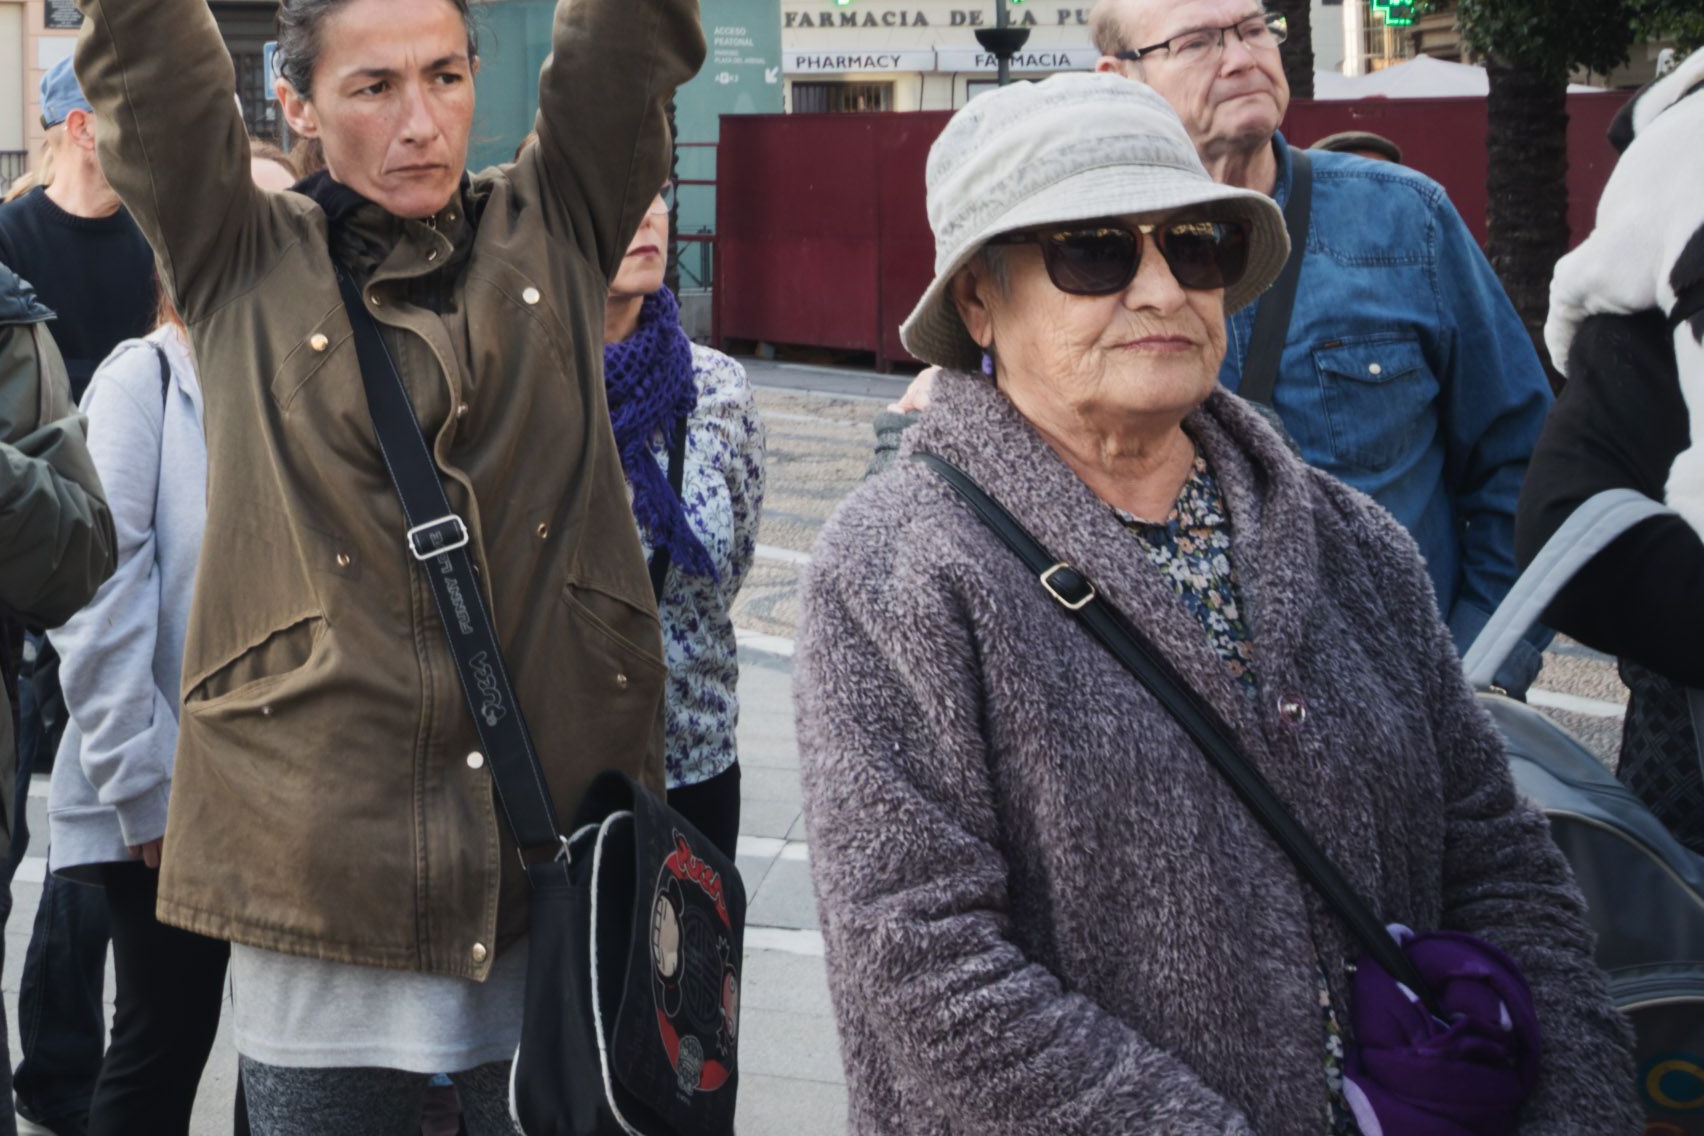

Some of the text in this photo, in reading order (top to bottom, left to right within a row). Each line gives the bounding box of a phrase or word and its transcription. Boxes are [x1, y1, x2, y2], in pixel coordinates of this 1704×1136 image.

[784, 10, 930, 28] FARMACIA
[950, 10, 984, 26] DE
[714, 27, 746, 36] ACCESO
[714, 38, 754, 47] PEATONAL
[796, 55, 902, 70] PHARMACY
[975, 53, 1072, 68] FAMACIA
